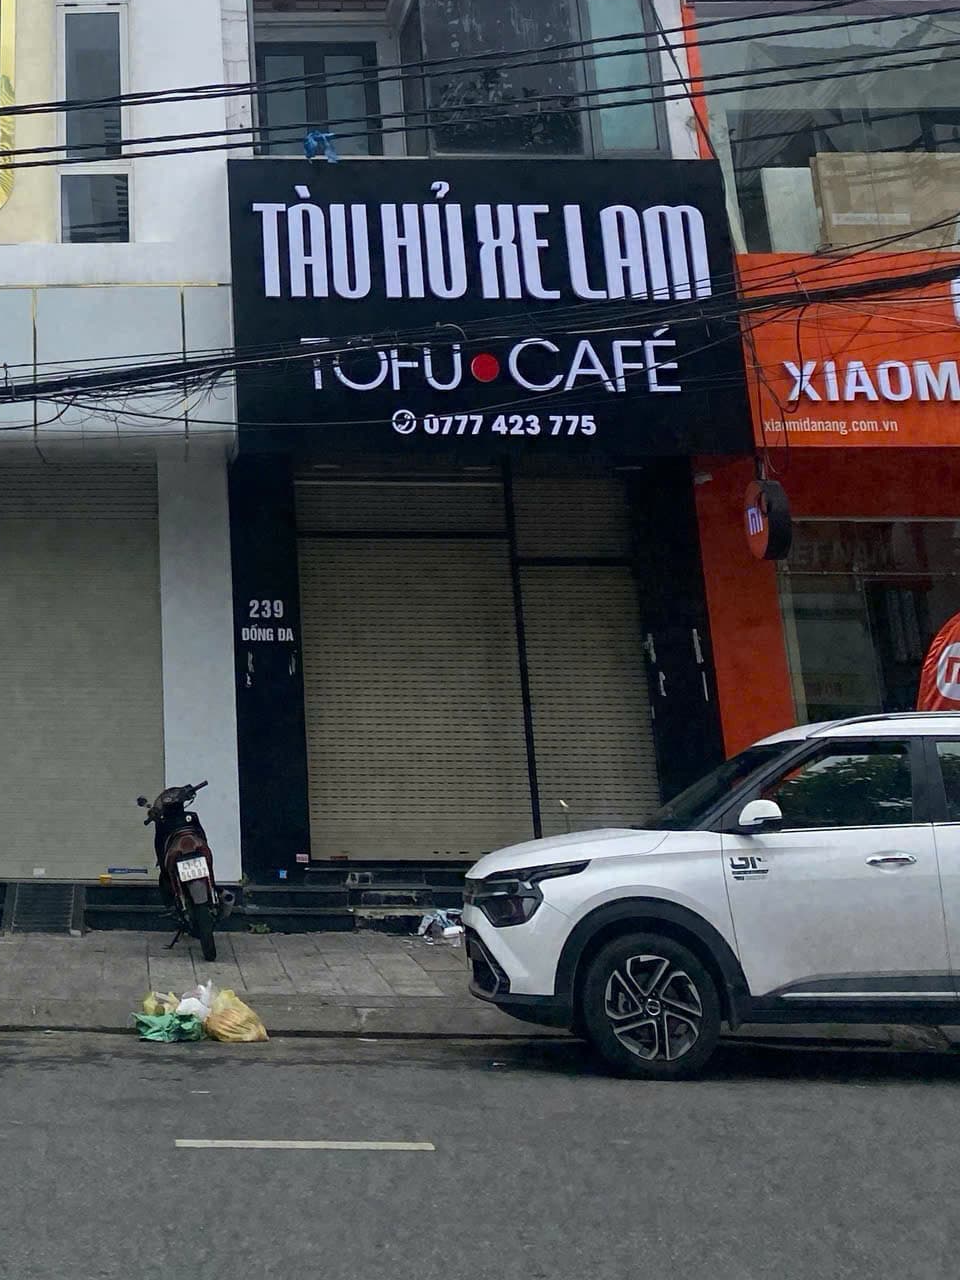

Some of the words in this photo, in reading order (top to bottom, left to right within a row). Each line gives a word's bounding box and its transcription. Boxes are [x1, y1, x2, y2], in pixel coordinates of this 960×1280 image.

[252, 185, 371, 299] TÀU
[380, 180, 468, 299] HỦ
[475, 204, 561, 300] XE
[563, 204, 712, 300] LAM
[300, 336, 463, 393] TOFU
[508, 327, 683, 394] CAFÉ
[424, 415, 482, 435] 0777
[491, 414, 542, 435] 423
[550, 414, 596, 435] 775
[765, 417, 898, 435] xiaomidanang.com.vn
[249, 600, 284, 618] 239
